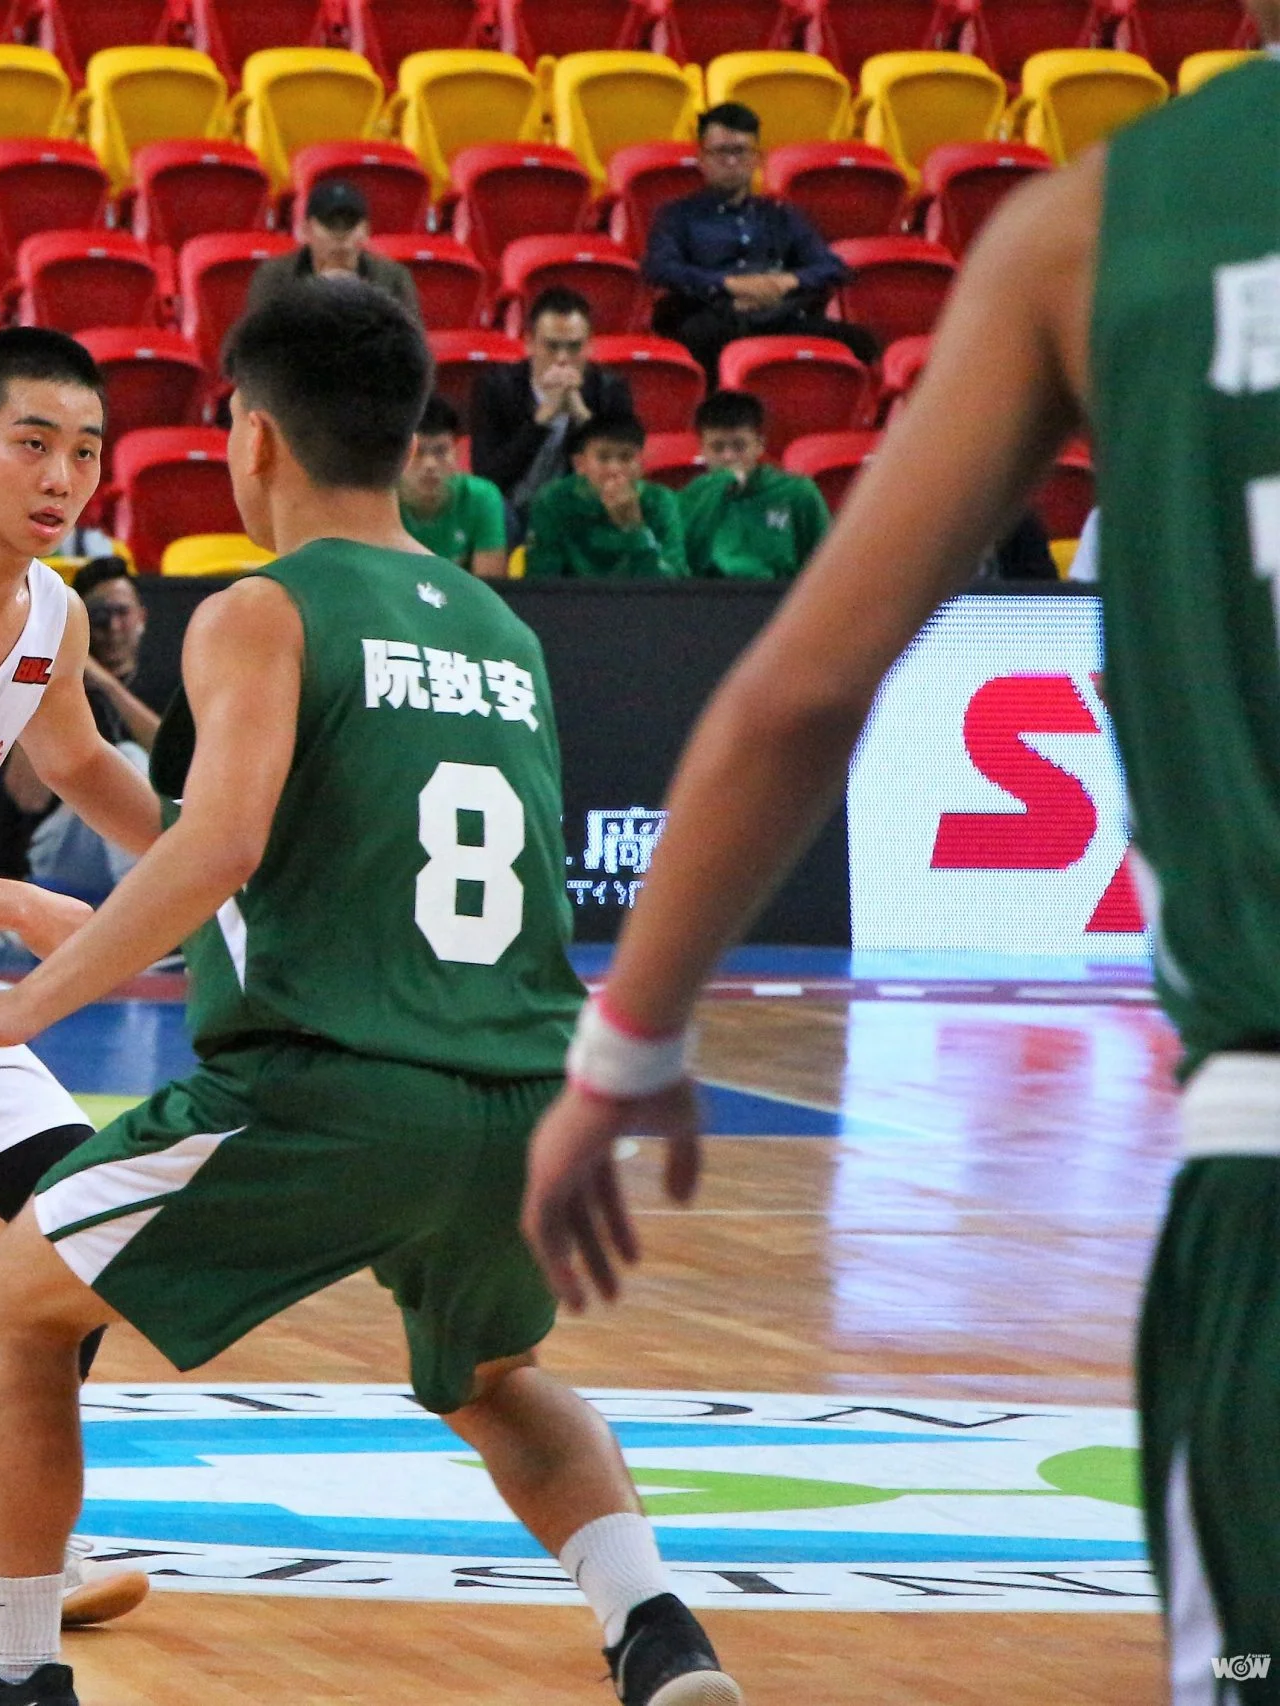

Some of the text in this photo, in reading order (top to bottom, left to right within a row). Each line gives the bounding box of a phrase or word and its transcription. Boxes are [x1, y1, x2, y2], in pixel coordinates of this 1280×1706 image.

[361, 638, 539, 733] 阮致安
[414, 761, 525, 966] 8
